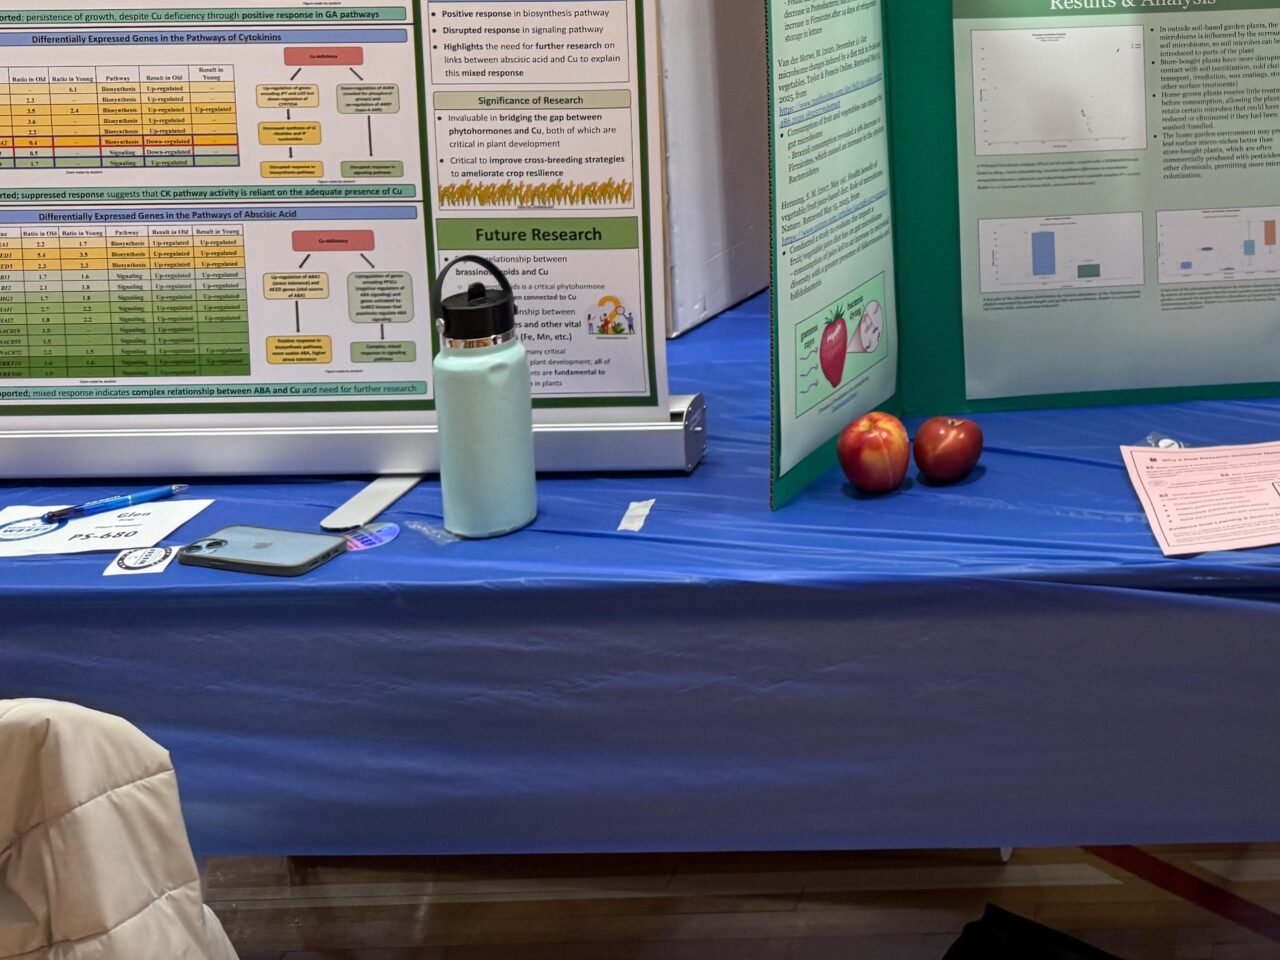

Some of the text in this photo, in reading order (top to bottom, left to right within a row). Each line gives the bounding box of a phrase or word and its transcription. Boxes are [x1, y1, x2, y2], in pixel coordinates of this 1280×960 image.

[478, 96, 584, 106] Significance of Research
[476, 227, 601, 240] Future Research
[68, 530, 139, 541] PS-680
